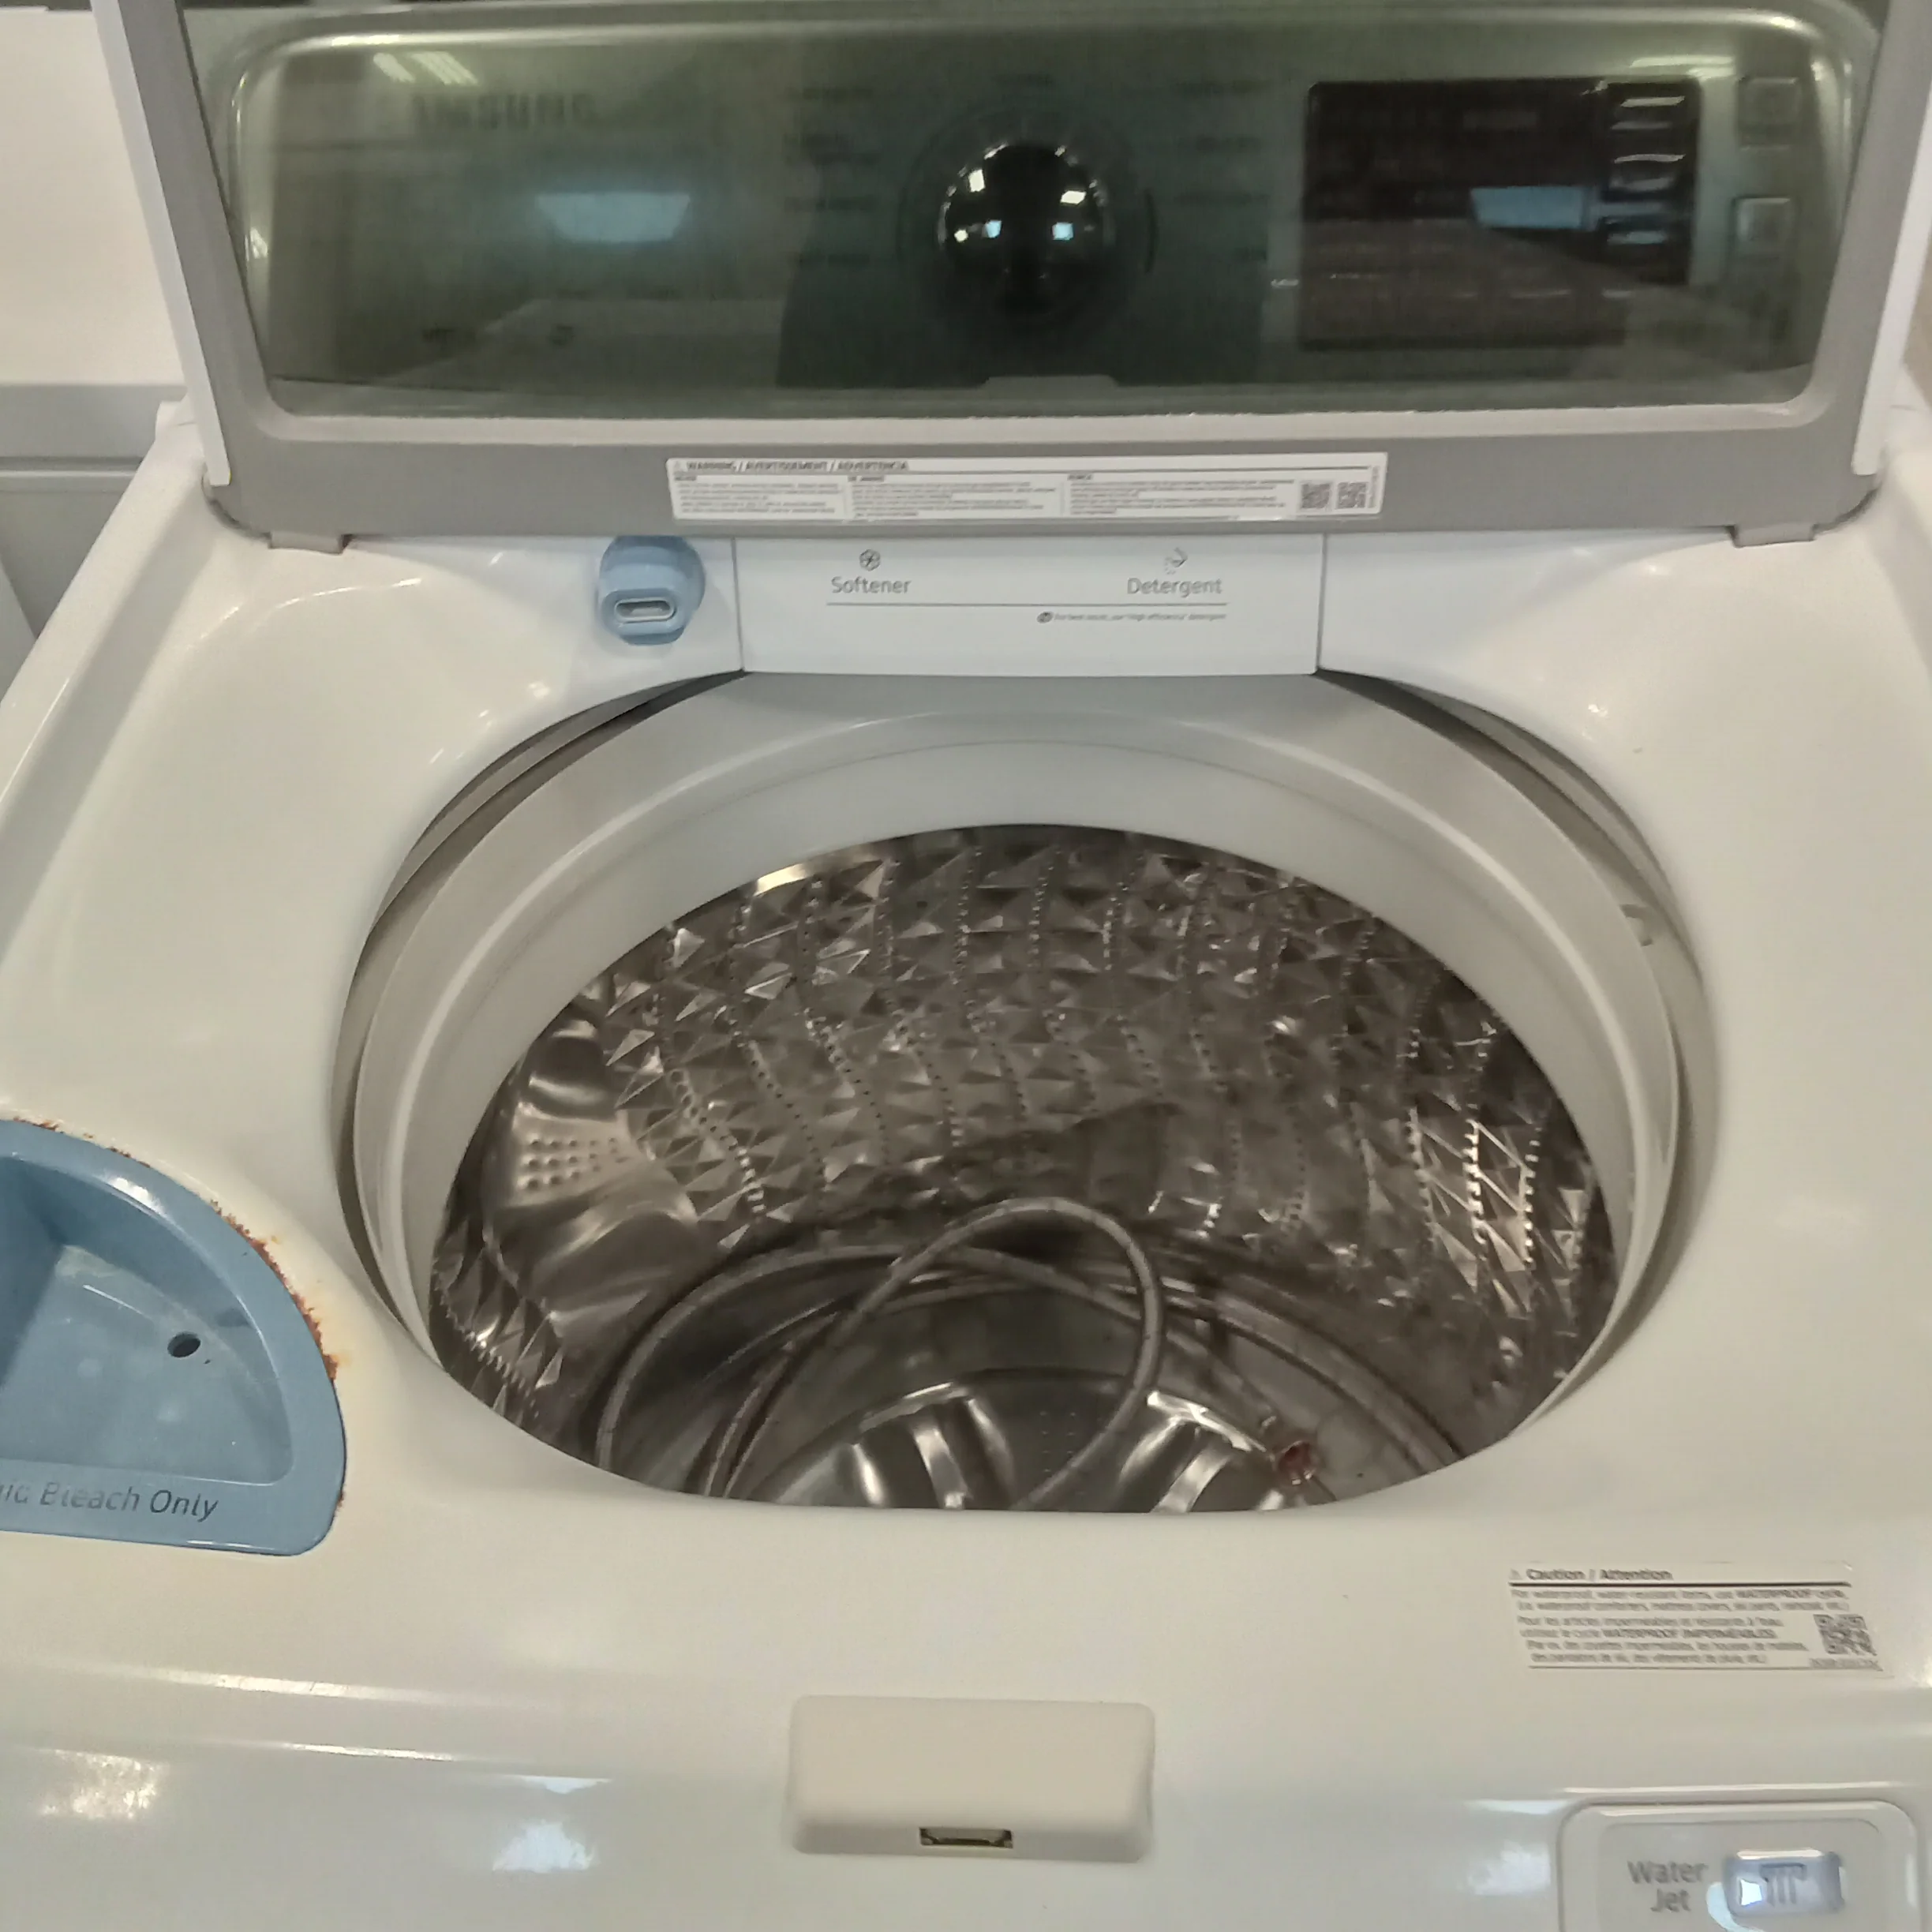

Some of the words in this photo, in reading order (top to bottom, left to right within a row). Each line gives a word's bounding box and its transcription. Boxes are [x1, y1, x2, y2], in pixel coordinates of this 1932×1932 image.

[831, 575, 912, 594] Softener
[1127, 577, 1222, 598] Detergent
[40, 1481, 140, 1512] Bleach
[149, 1489, 219, 1522] Only
[1627, 1860, 1709, 1884] Water
[1649, 1888, 1691, 1912] Jet
